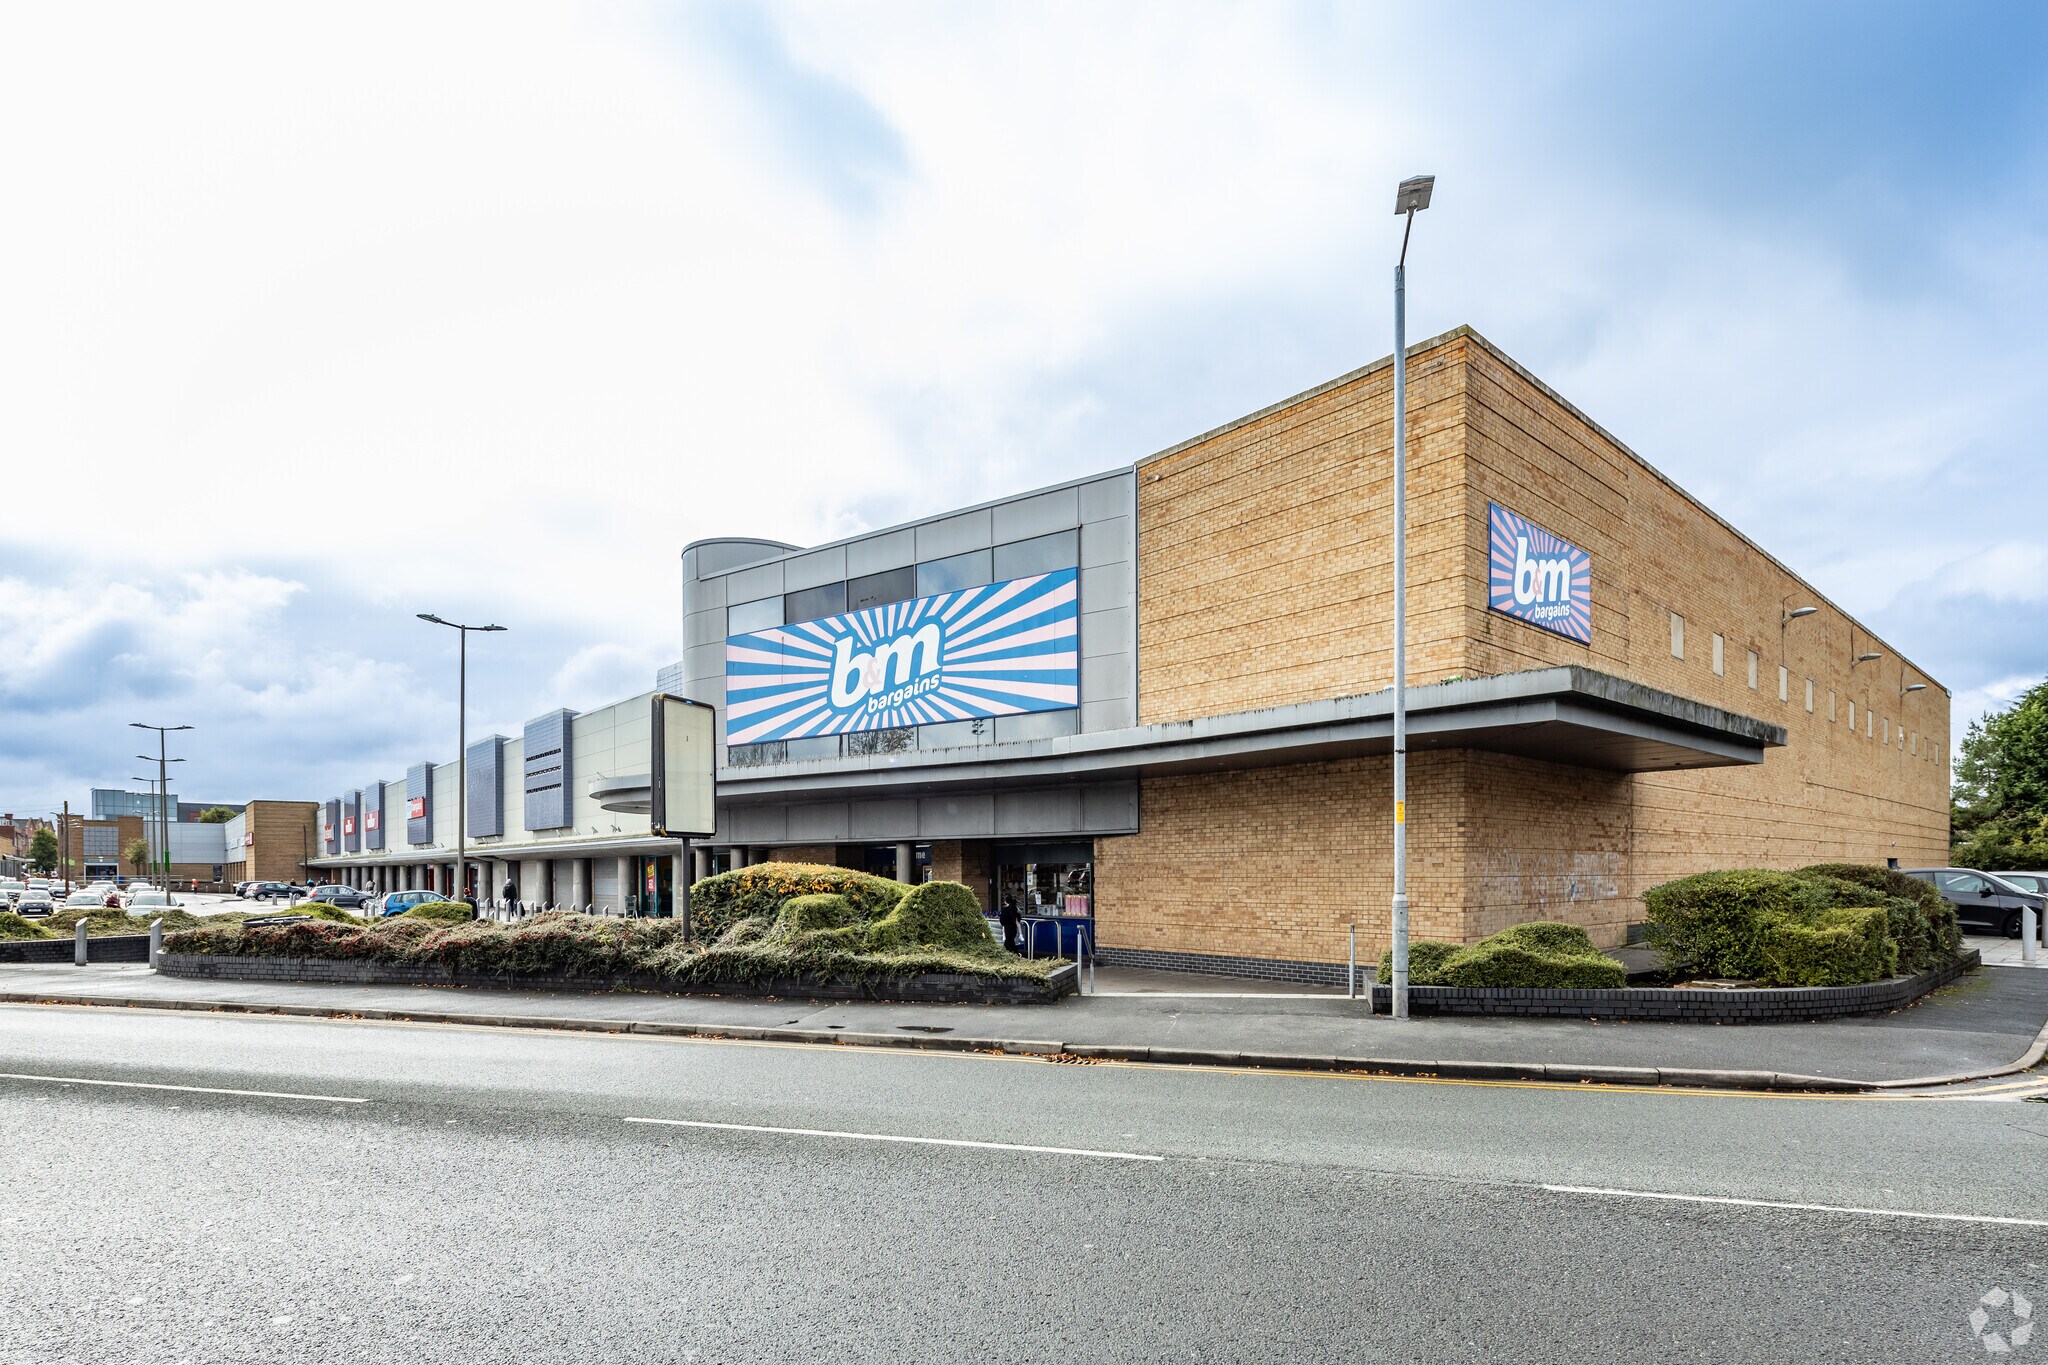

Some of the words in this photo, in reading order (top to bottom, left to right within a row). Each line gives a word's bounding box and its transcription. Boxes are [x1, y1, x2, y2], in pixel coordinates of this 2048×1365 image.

[1514, 537, 1570, 605] b&m
[1535, 602, 1570, 620] bargains
[831, 623, 942, 708] b&m
[868, 674, 940, 714] bargains
